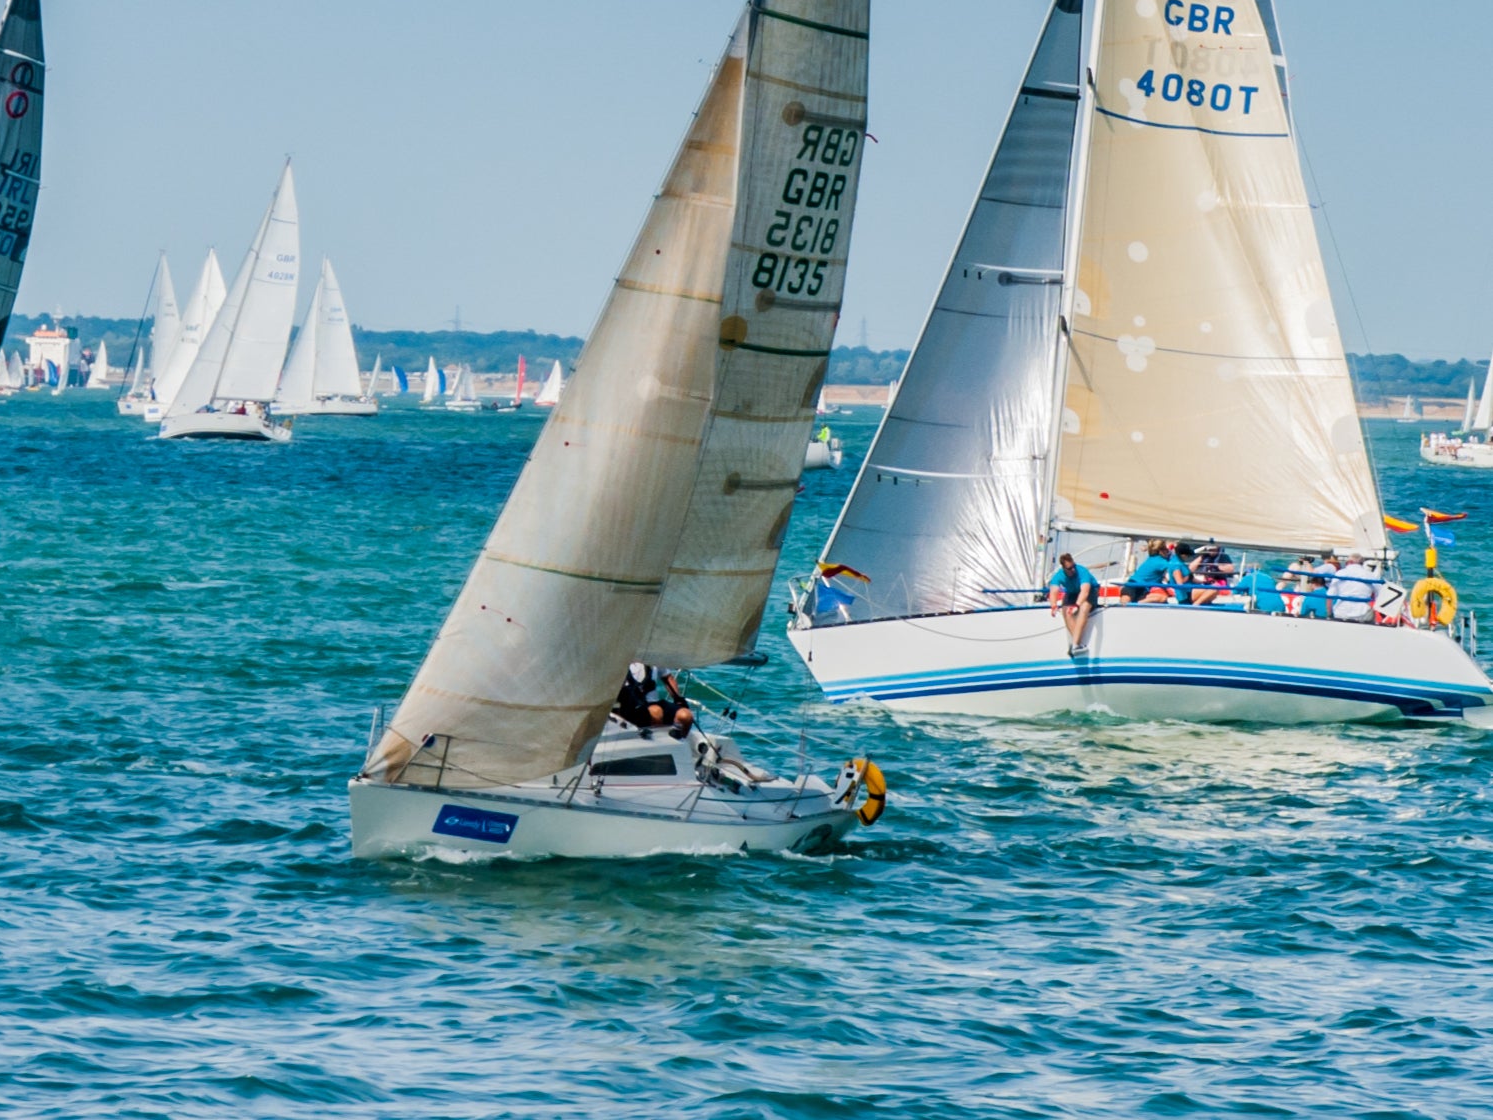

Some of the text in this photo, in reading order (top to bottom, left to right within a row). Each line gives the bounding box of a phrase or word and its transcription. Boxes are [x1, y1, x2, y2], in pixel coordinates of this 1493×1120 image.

[1136, 69, 1259, 115] 4080T
[782, 168, 847, 211] GBR
[751, 252, 829, 296] 8135
[1381, 586, 1403, 608] 7
